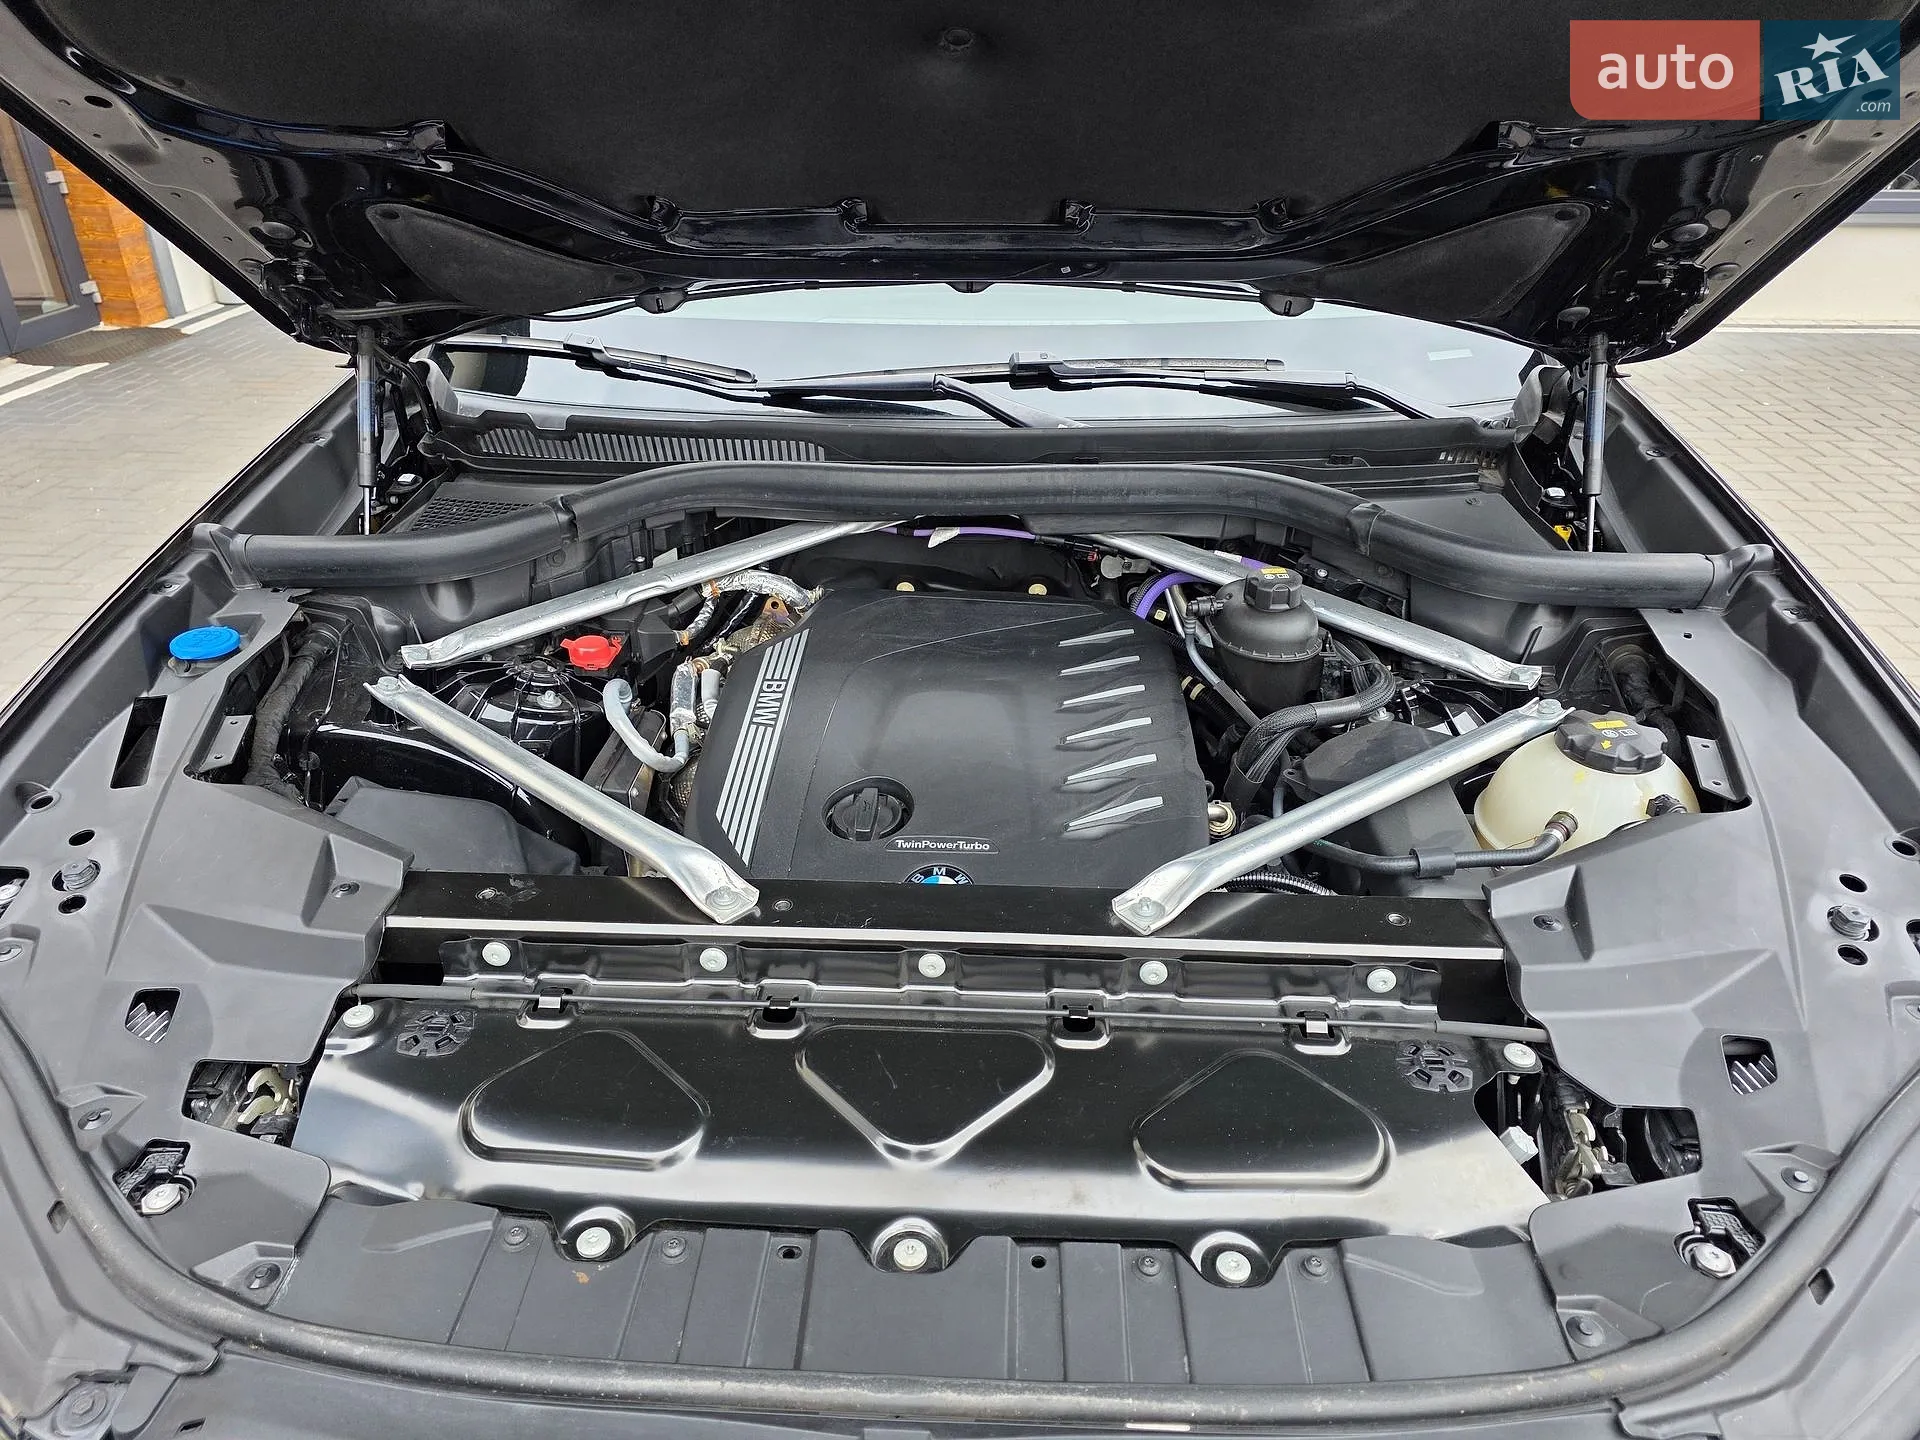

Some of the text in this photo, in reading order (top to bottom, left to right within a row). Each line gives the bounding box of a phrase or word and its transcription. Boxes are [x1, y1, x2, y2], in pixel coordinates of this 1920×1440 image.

[752, 680, 787, 725] BMW
[895, 839, 990, 850] TwinPowerTurbo
[910, 866, 970, 885] BMW
